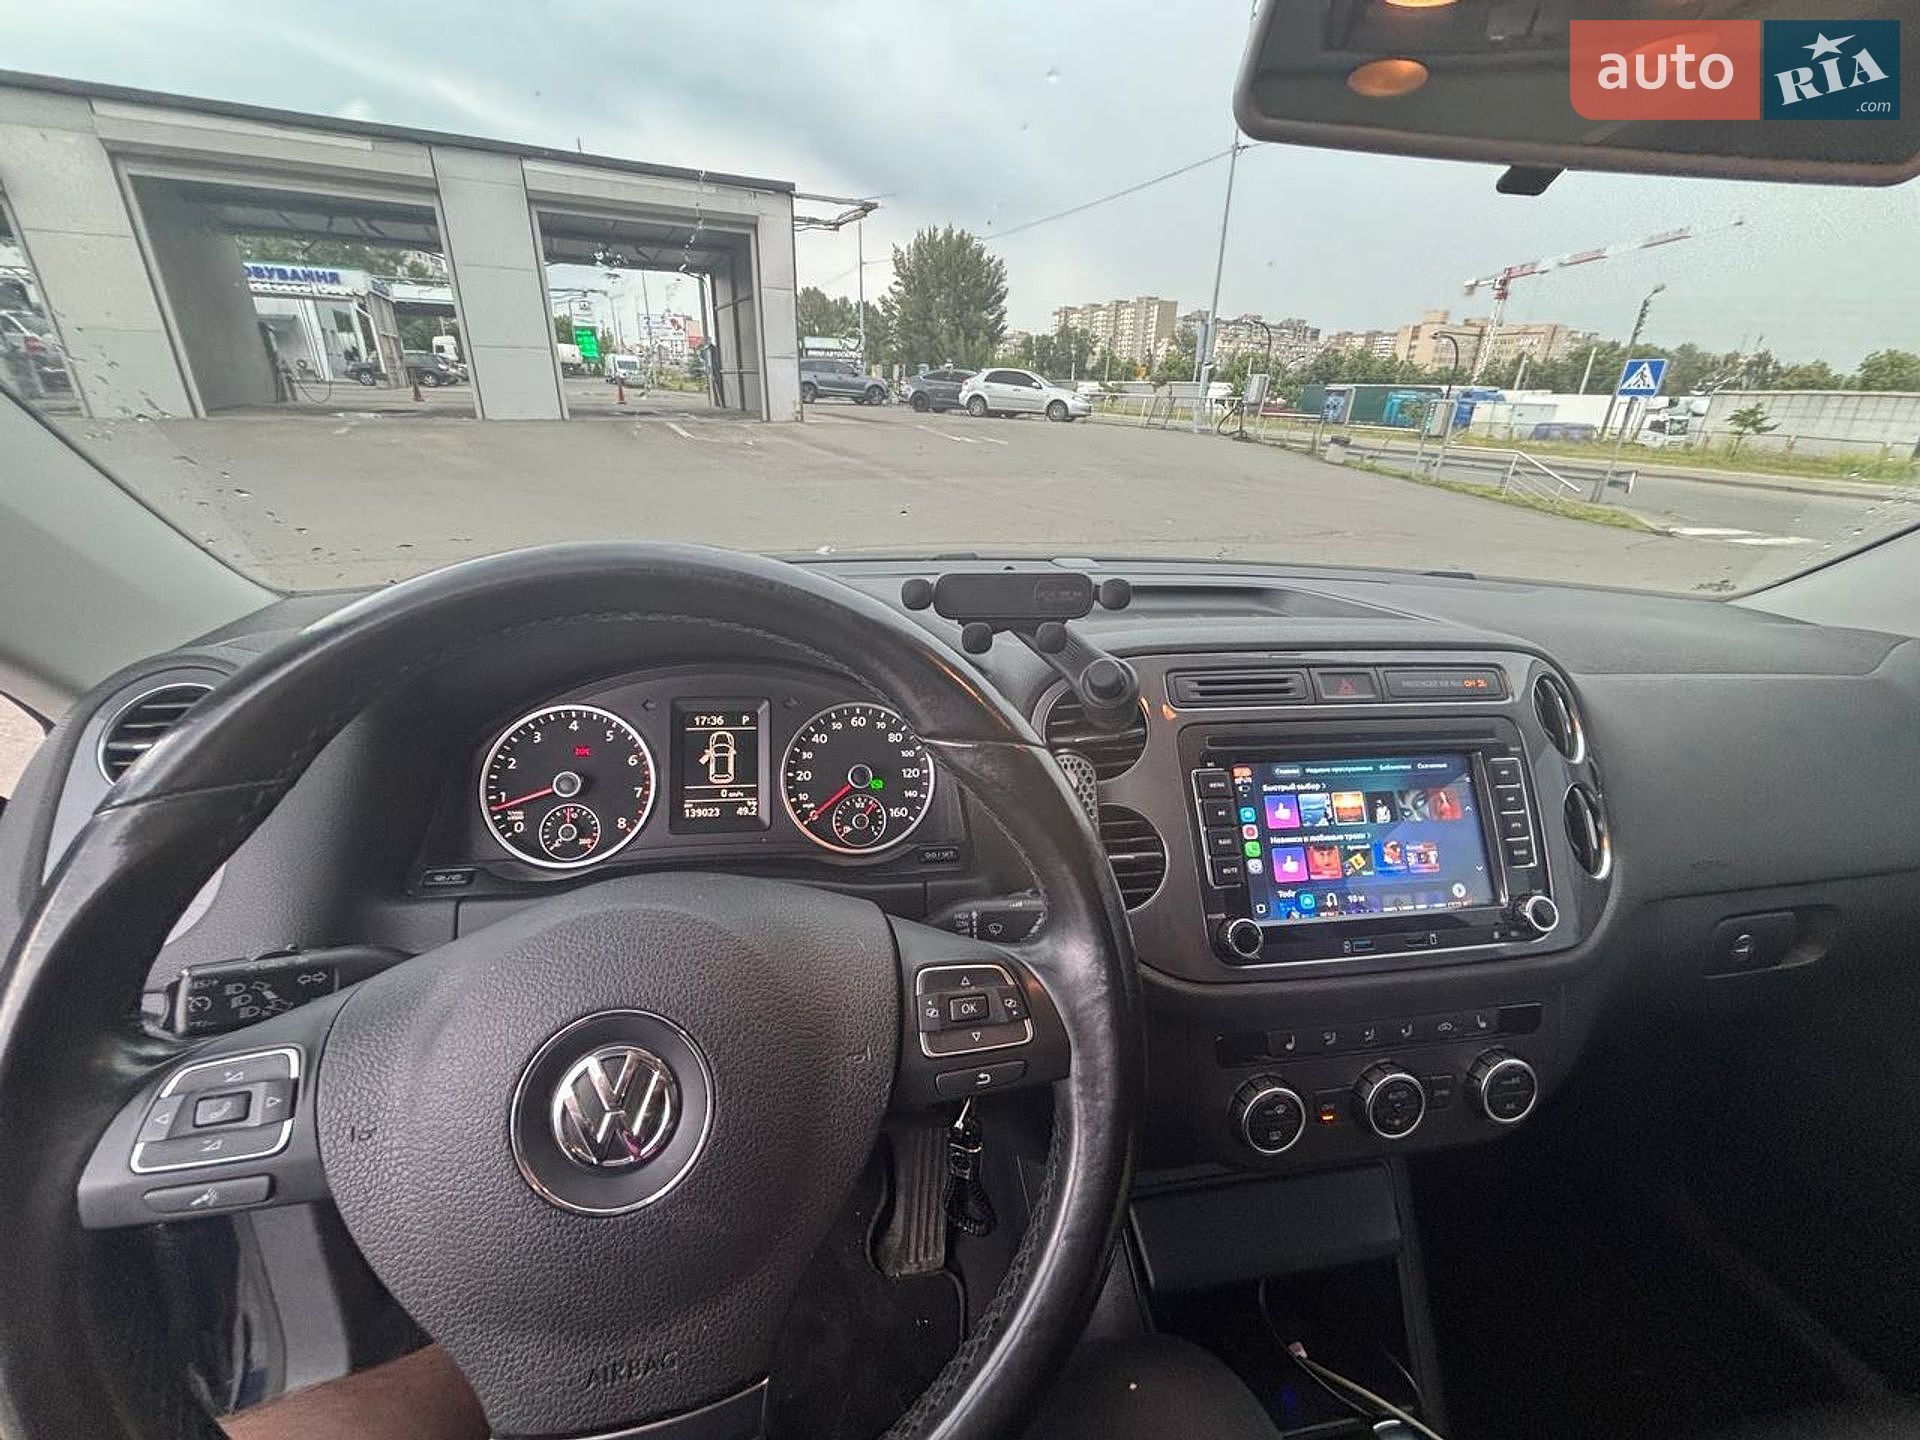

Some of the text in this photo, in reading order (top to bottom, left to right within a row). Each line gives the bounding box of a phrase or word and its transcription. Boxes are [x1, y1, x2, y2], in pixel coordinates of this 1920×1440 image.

[569, 720, 578, 731] 4
[694, 715, 750, 726] 17:36 P
[850, 717, 866, 727] 60
[533, 732, 542, 743] 3
[605, 731, 614, 742] 5
[812, 734, 828, 744] 40
[888, 733, 902, 743] 80
[900, 750, 915, 758] 100
[507, 758, 517, 769] 2
[628, 755, 638, 766] 6
[796, 771, 812, 781] 20
[902, 768, 920, 778] 120
[634, 787, 643, 798] 7
[685, 807, 757, 818] 139023 49.2
[889, 807, 908, 817] 160
[514, 821, 524, 833] 0
[617, 818, 627, 829] 8
[961, 1003, 977, 1014] OK
